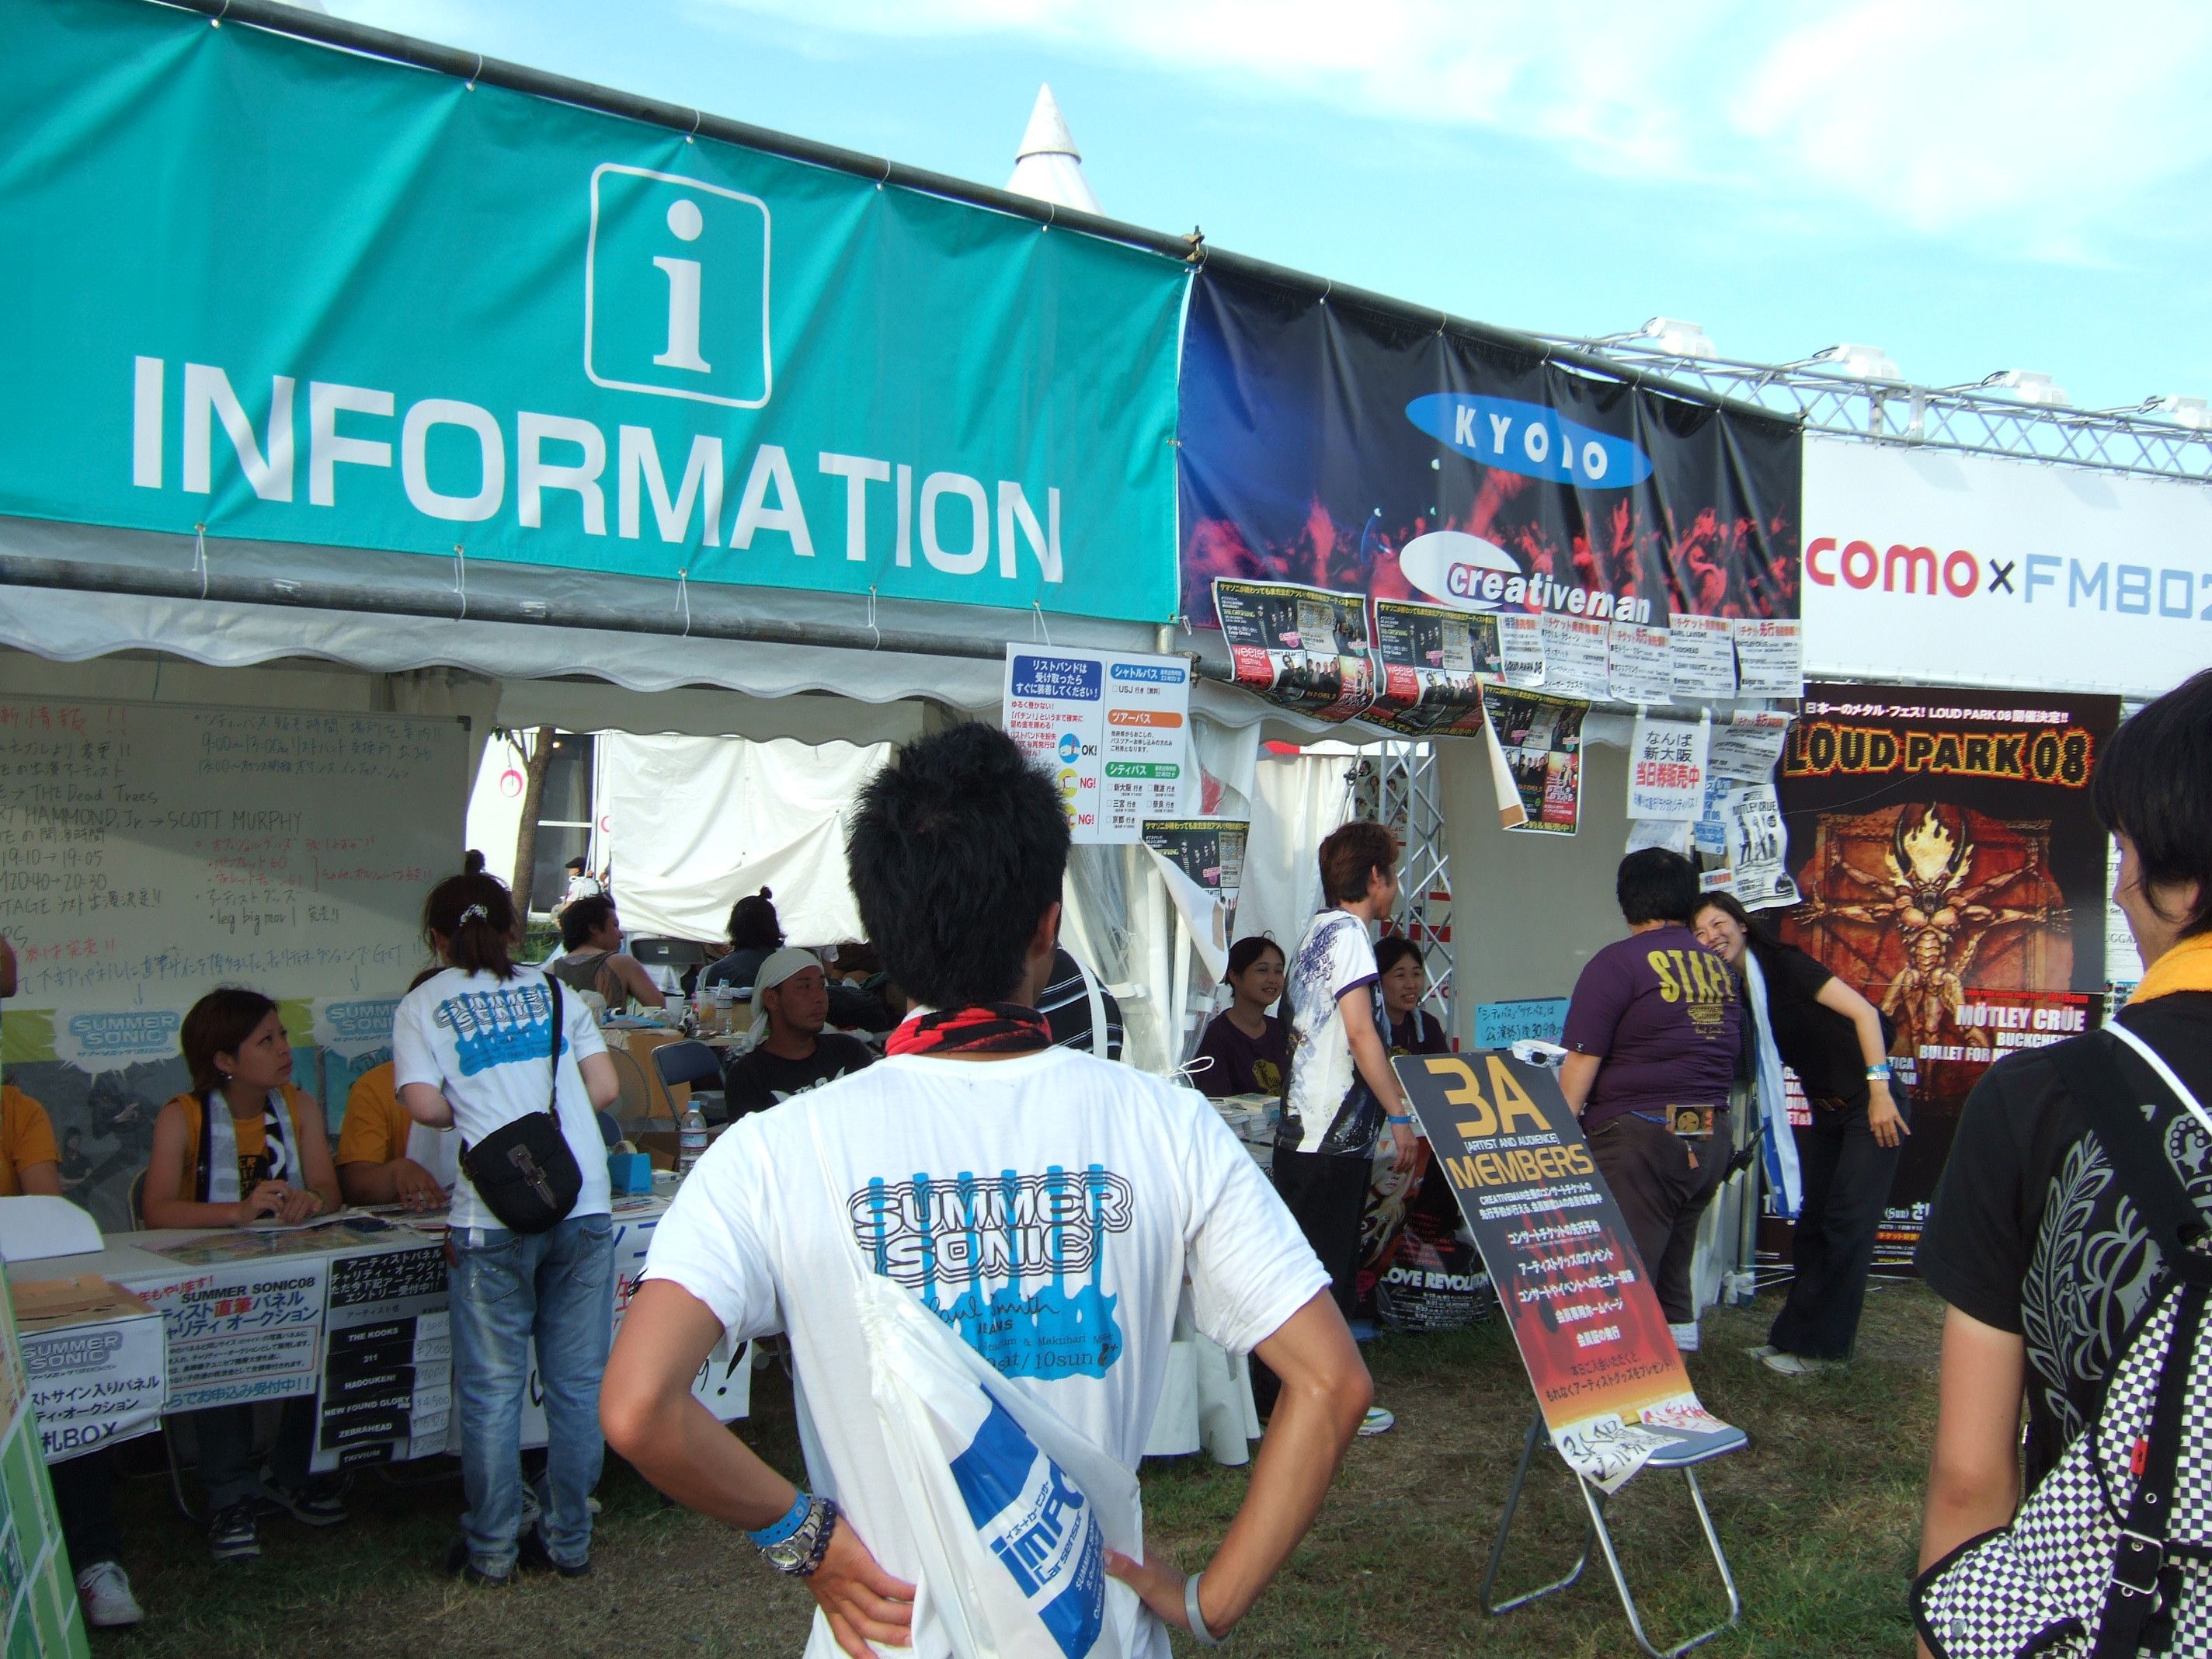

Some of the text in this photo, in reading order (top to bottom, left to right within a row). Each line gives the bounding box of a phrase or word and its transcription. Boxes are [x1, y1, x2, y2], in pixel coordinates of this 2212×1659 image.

[131, 355, 1064, 583] INFORMATION
[1449, 565, 1651, 624] creativeman
[1033, 660, 1087, 673] リストバンドは
[1115, 666, 1158, 680] シャトルバス
[1035, 673, 1083, 685] 受け取ったら
[1016, 683, 1097, 697] すぐに装着してください!
[1118, 685, 1133, 694] USJ
[1112, 711, 1151, 724] ツアーバス
[1929, 708, 1962, 720] LOUD
[1646, 731, 1692, 746] なんば
[1081, 745, 1097, 756] OK!
[1643, 746, 1692, 763] 新大阪
[1783, 722, 2095, 789] LOUD PARK 08
[1110, 763, 1146, 775] シティバス
[1080, 777, 1096, 788] NG!
[68, 784, 103, 803] Dead
[167, 809, 221, 830] SCOTT
[233, 810, 303, 835] MURPHY
[1078, 814, 1094, 825] NG!
[329, 1004, 398, 1020] SUMM
[1955, 1001, 2086, 1032] MÖTLEY CRÜE
[75, 1015, 176, 1032] SUMMER
[342, 1017, 393, 1031] SONI
[86, 1029, 165, 1045] SONIC
[1996, 1031, 2074, 1049] BUCKCHE
[1919, 1045, 1991, 1062] BULLET FOR
[1424, 1056, 1553, 1138] 3A
[1499, 1137, 1518, 1149] AND
[1445, 1143, 1595, 1190] MEMBERS
[849, 1177, 1131, 1244] SUMMER
[882, 1222, 1096, 1280] SONIC
[332, 1261, 446, 1285] チャリティ・オークショ
[181, 1277, 316, 1305] SUMMER SONIC08
[989, 1293, 1059, 1316] Smith
[227, 1309, 318, 1330] オークション
[978, 1319, 1013, 1335] JEANS
[349, 1333, 366, 1343] THE
[1038, 1334, 1087, 1348] Makuhari
[23, 1334, 121, 1360] SUMMER
[30, 1349, 105, 1370] SONIC
[324, 1408, 344, 1418] NEW
[338, 1422, 392, 1438] ZEBRAHEAD
